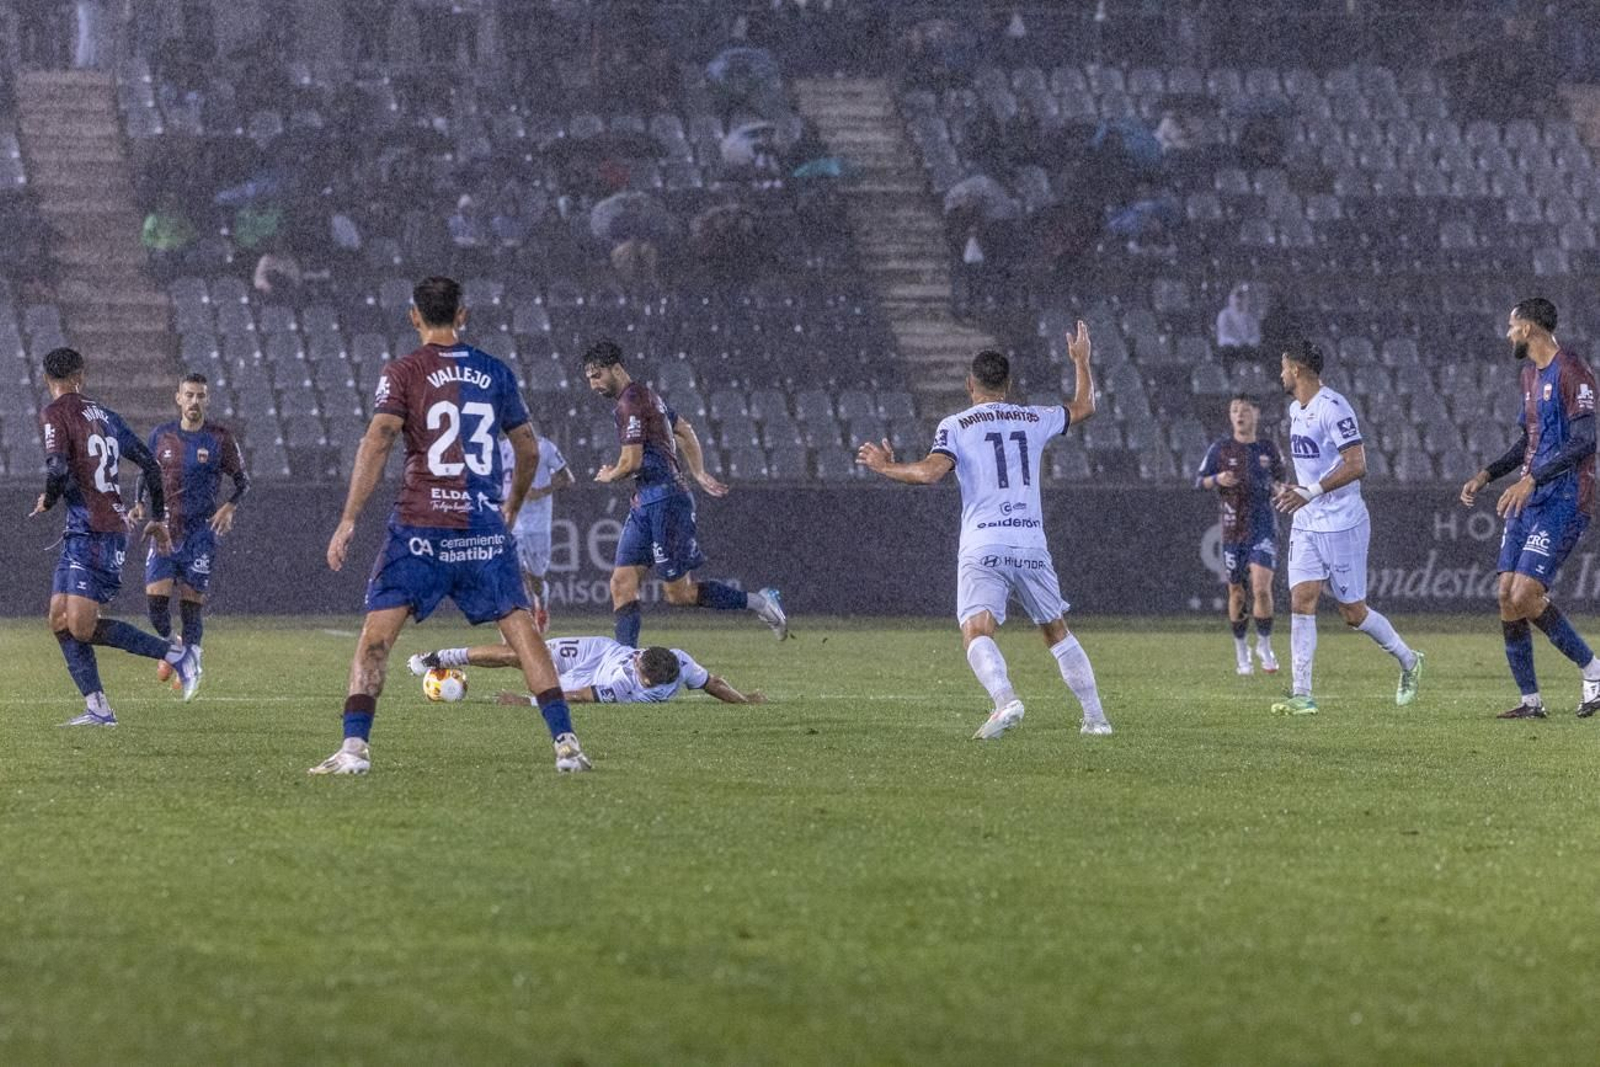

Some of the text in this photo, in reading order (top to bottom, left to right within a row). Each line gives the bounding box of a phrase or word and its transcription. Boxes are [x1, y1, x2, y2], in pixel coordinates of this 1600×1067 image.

[426, 365, 492, 390] VALLEJO
[959, 411, 995, 429] MARIO
[426, 400, 496, 477] 23
[87, 433, 120, 494] 22
[984, 430, 1031, 489] 11
[430, 488, 472, 501] ELDA
[1432, 511, 1498, 541] HO
[559, 639, 579, 658] 16
